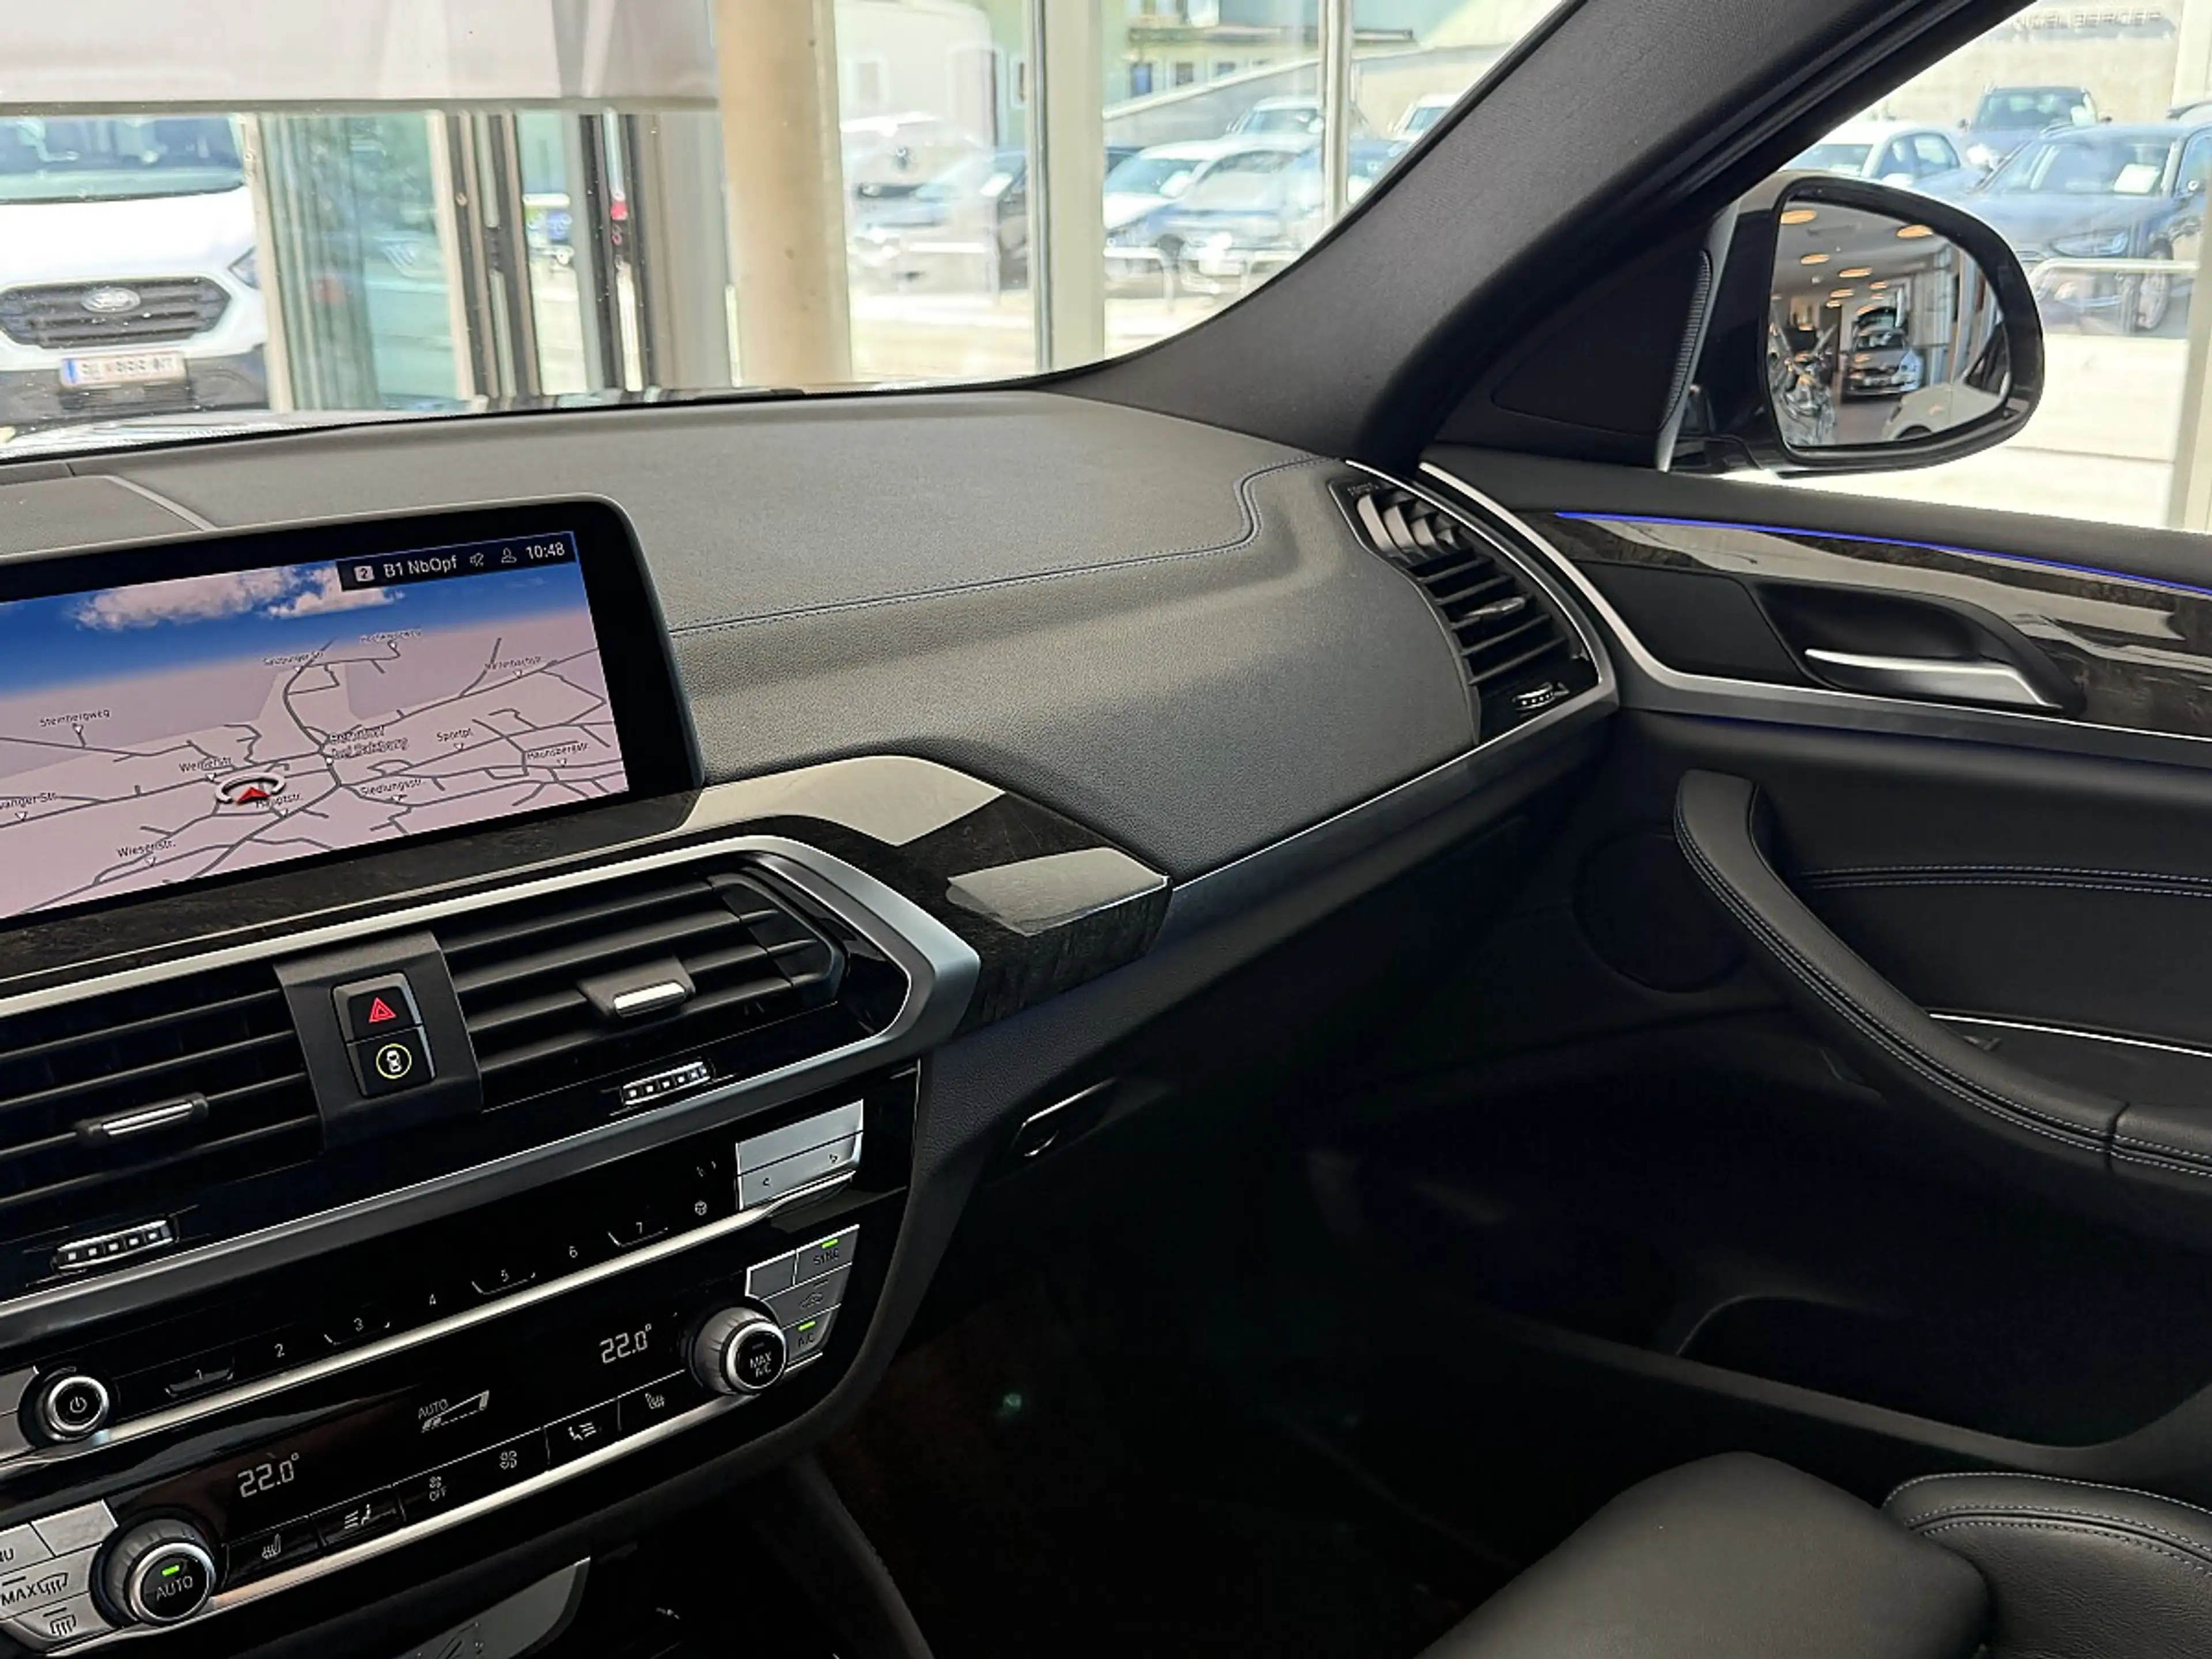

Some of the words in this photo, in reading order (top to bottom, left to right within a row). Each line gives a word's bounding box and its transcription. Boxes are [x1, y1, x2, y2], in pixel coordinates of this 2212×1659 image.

[383, 562, 403, 578] B1
[407, 555, 457, 574] NbOpf
[526, 542, 565, 559] 10:48
[636, 1222, 643, 1234] 7
[569, 1245, 578, 1258] 6
[501, 1270, 509, 1282] 5
[353, 1317, 364, 1331] 3
[274, 1343, 285, 1358] 2
[750, 1351, 772, 1369] MAX
[418, 1399, 449, 1420] AUTO
[1, 1584, 37, 1606] MAX
[156, 1575, 194, 1601] AUTO
